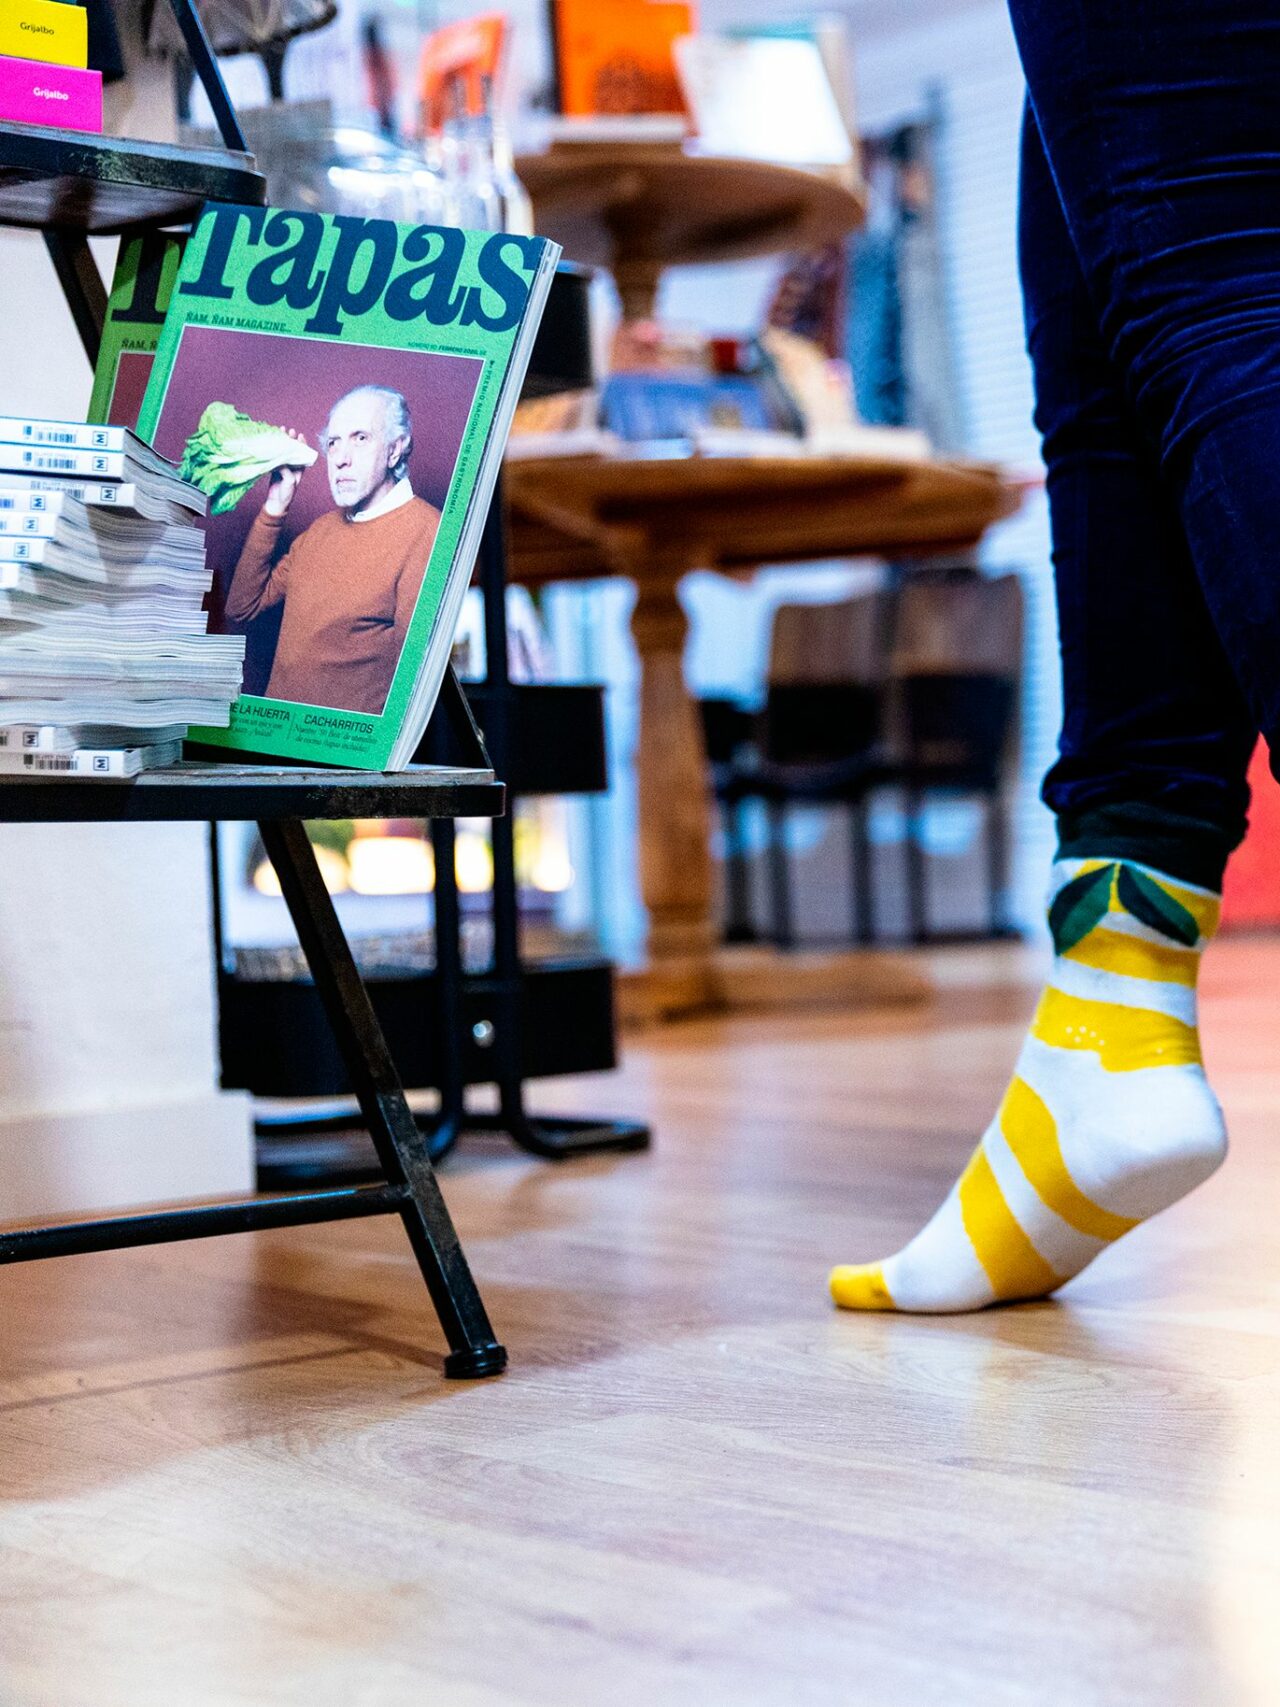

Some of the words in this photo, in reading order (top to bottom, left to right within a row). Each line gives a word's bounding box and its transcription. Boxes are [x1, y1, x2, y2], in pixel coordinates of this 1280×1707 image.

[20, 22, 55, 35] Grijalbo
[33, 87, 69, 100] Grijalbo
[179, 202, 538, 334] Tapas
[480, 370, 493, 400] PREMIO
[469, 402, 483, 441] NACIONAL
[240, 704, 251, 714] LA
[253, 706, 290, 721] HUERTA
[304, 714, 374, 734] CACHARRITOS
